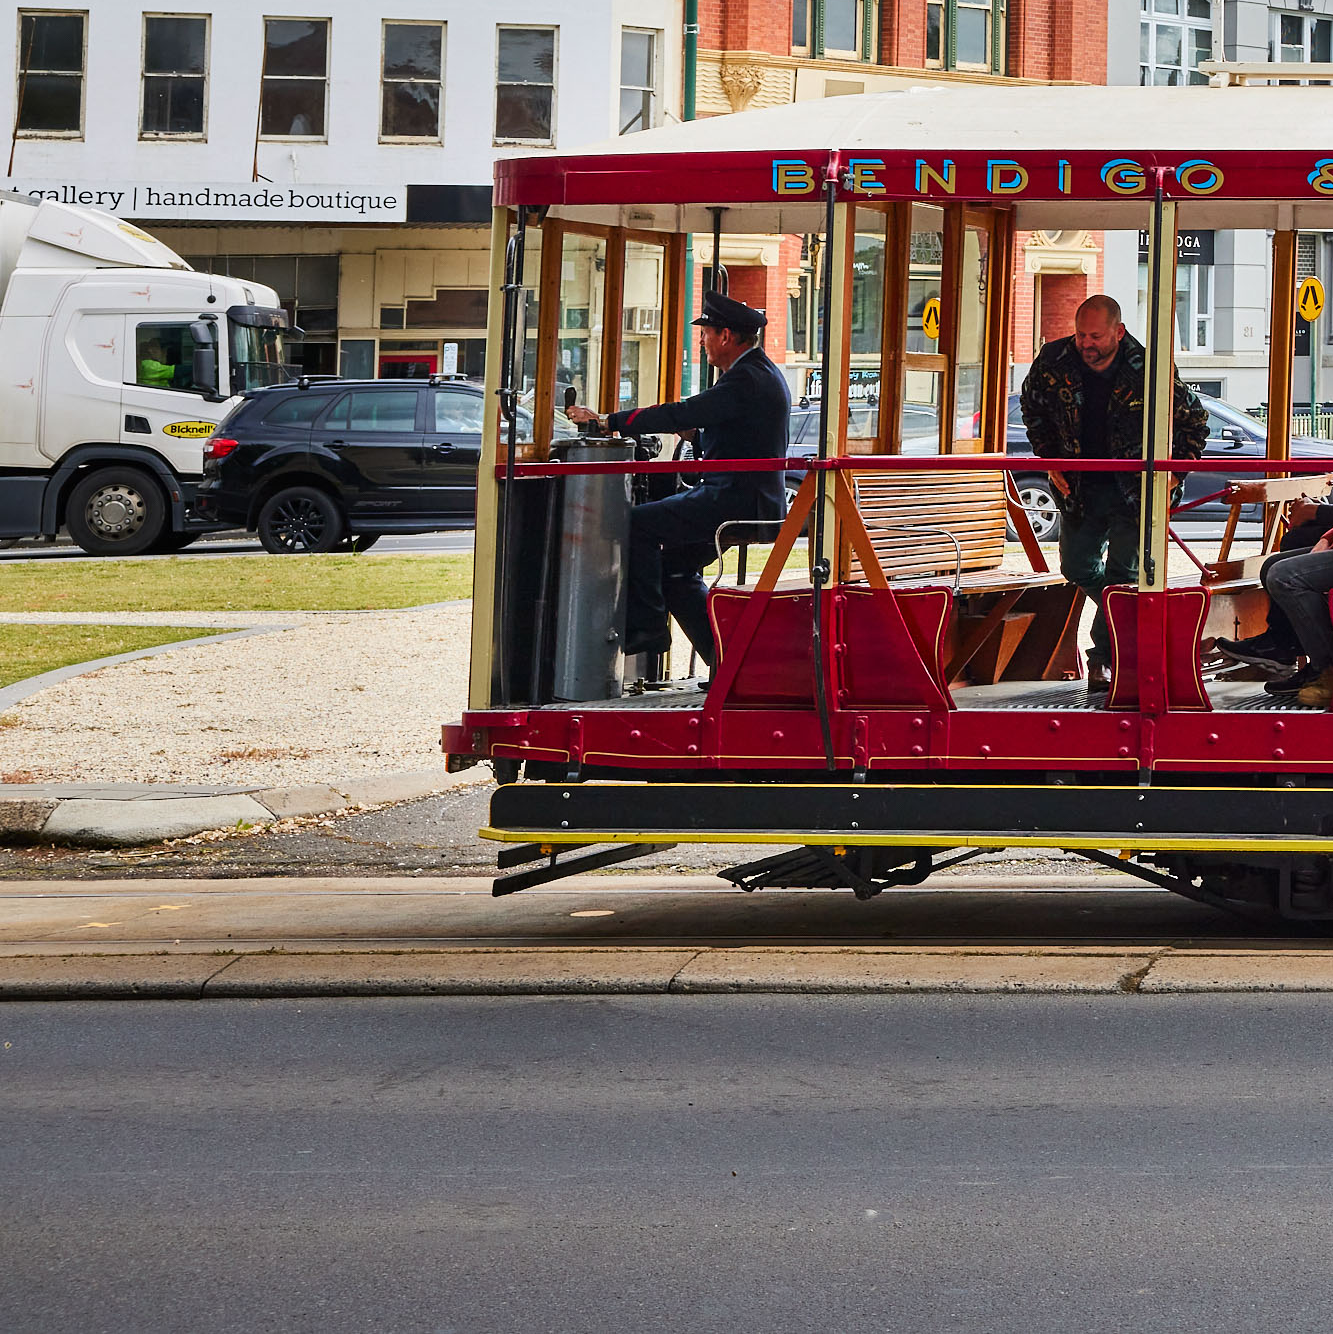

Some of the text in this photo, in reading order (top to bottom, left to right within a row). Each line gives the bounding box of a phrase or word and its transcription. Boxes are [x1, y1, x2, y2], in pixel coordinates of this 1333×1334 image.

[772, 158, 1225, 195] BENDIGO
[145, 188, 284, 208] handmade
[288, 189, 398, 214] boutique
[1176, 236, 1201, 248] OGA
